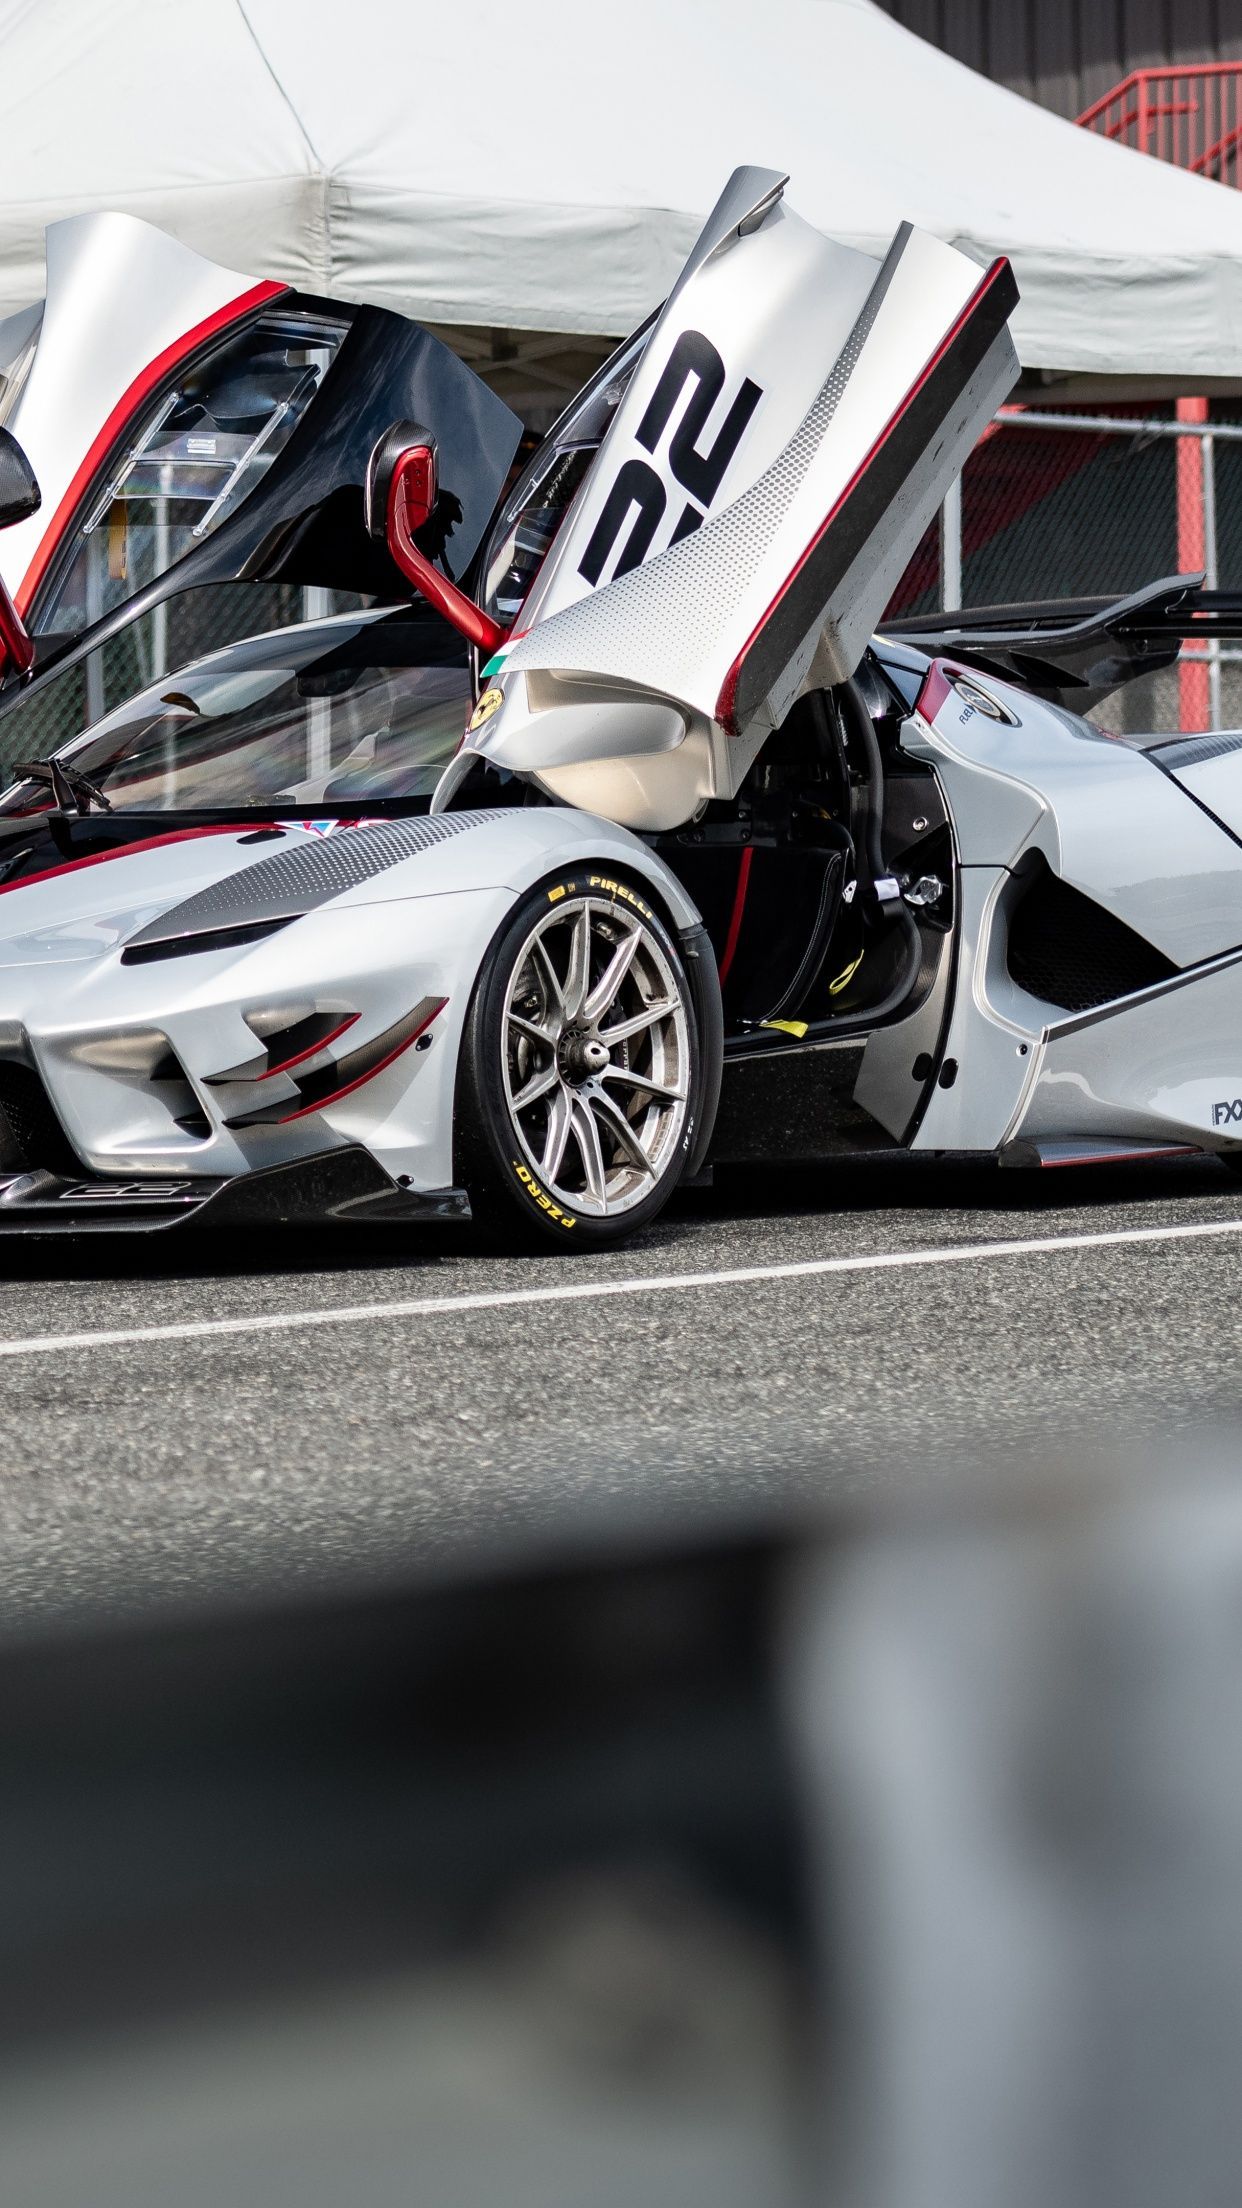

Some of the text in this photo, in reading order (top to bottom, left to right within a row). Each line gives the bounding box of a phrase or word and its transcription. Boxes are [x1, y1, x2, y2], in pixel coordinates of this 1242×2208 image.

[959, 708, 974, 725] FUEL
[590, 876, 652, 919] PIRELLI
[59, 1181, 192, 1199] 22
